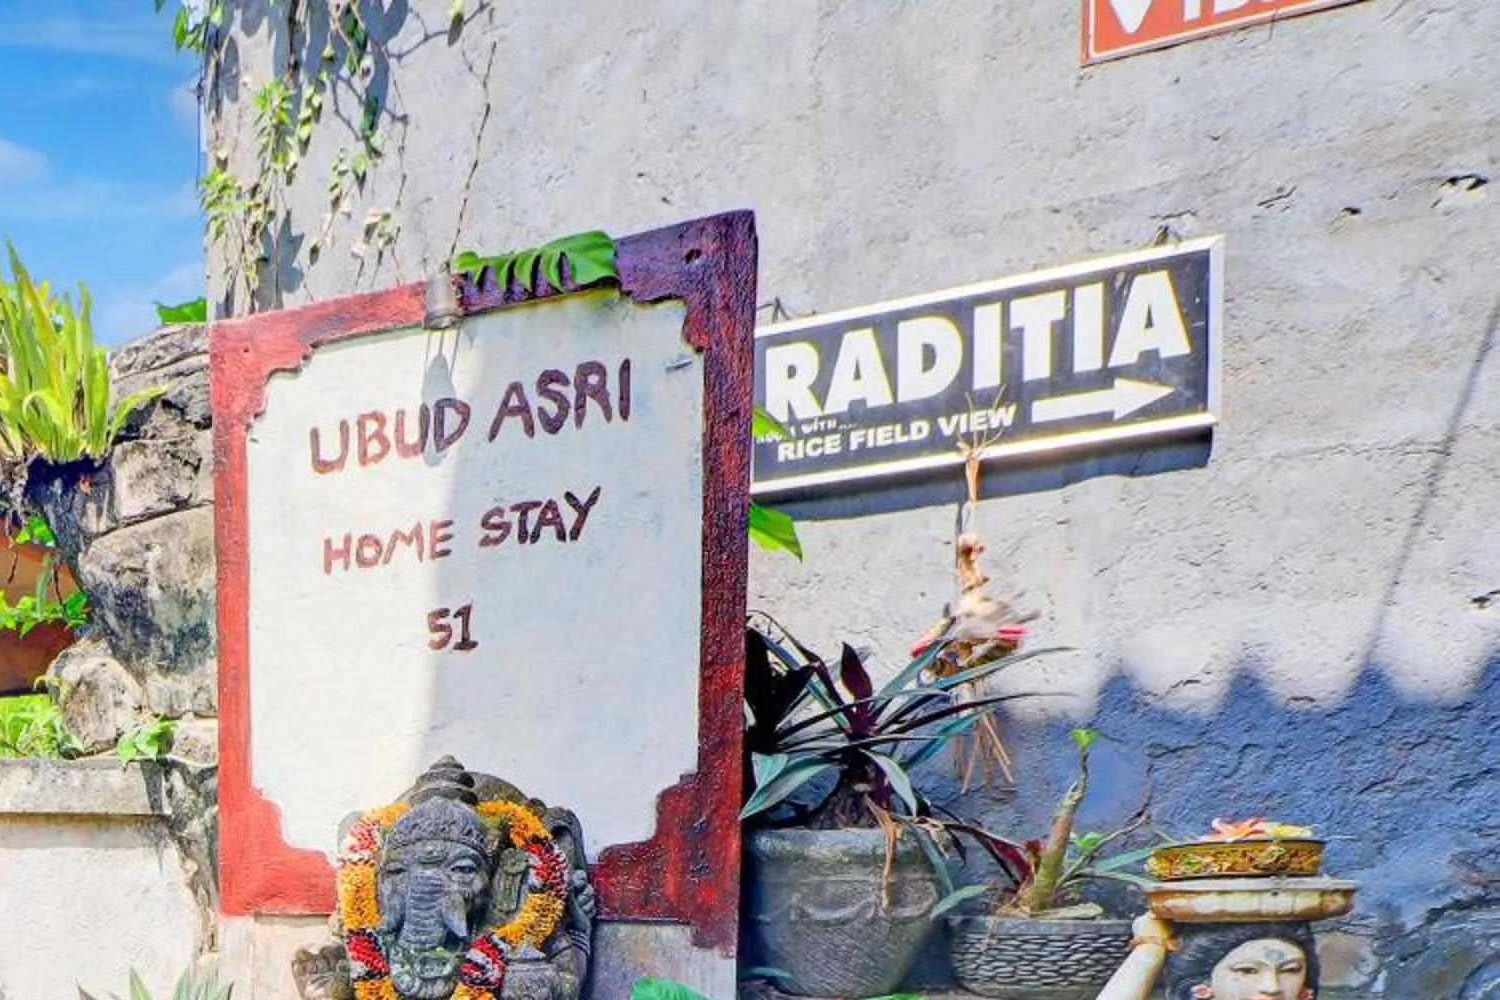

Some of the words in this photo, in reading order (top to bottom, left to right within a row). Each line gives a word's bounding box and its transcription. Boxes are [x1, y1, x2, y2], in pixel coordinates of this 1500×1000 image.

[766, 270, 1192, 423] RADITIA
[309, 397, 472, 475] UBUD
[487, 357, 632, 444] ASRI
[777, 433, 843, 463] RICE
[849, 419, 931, 451] FIELD
[936, 403, 1018, 438] VIEW
[322, 518, 454, 575] HOME
[478, 485, 602, 547] STAY
[426, 602, 479, 652] 51
